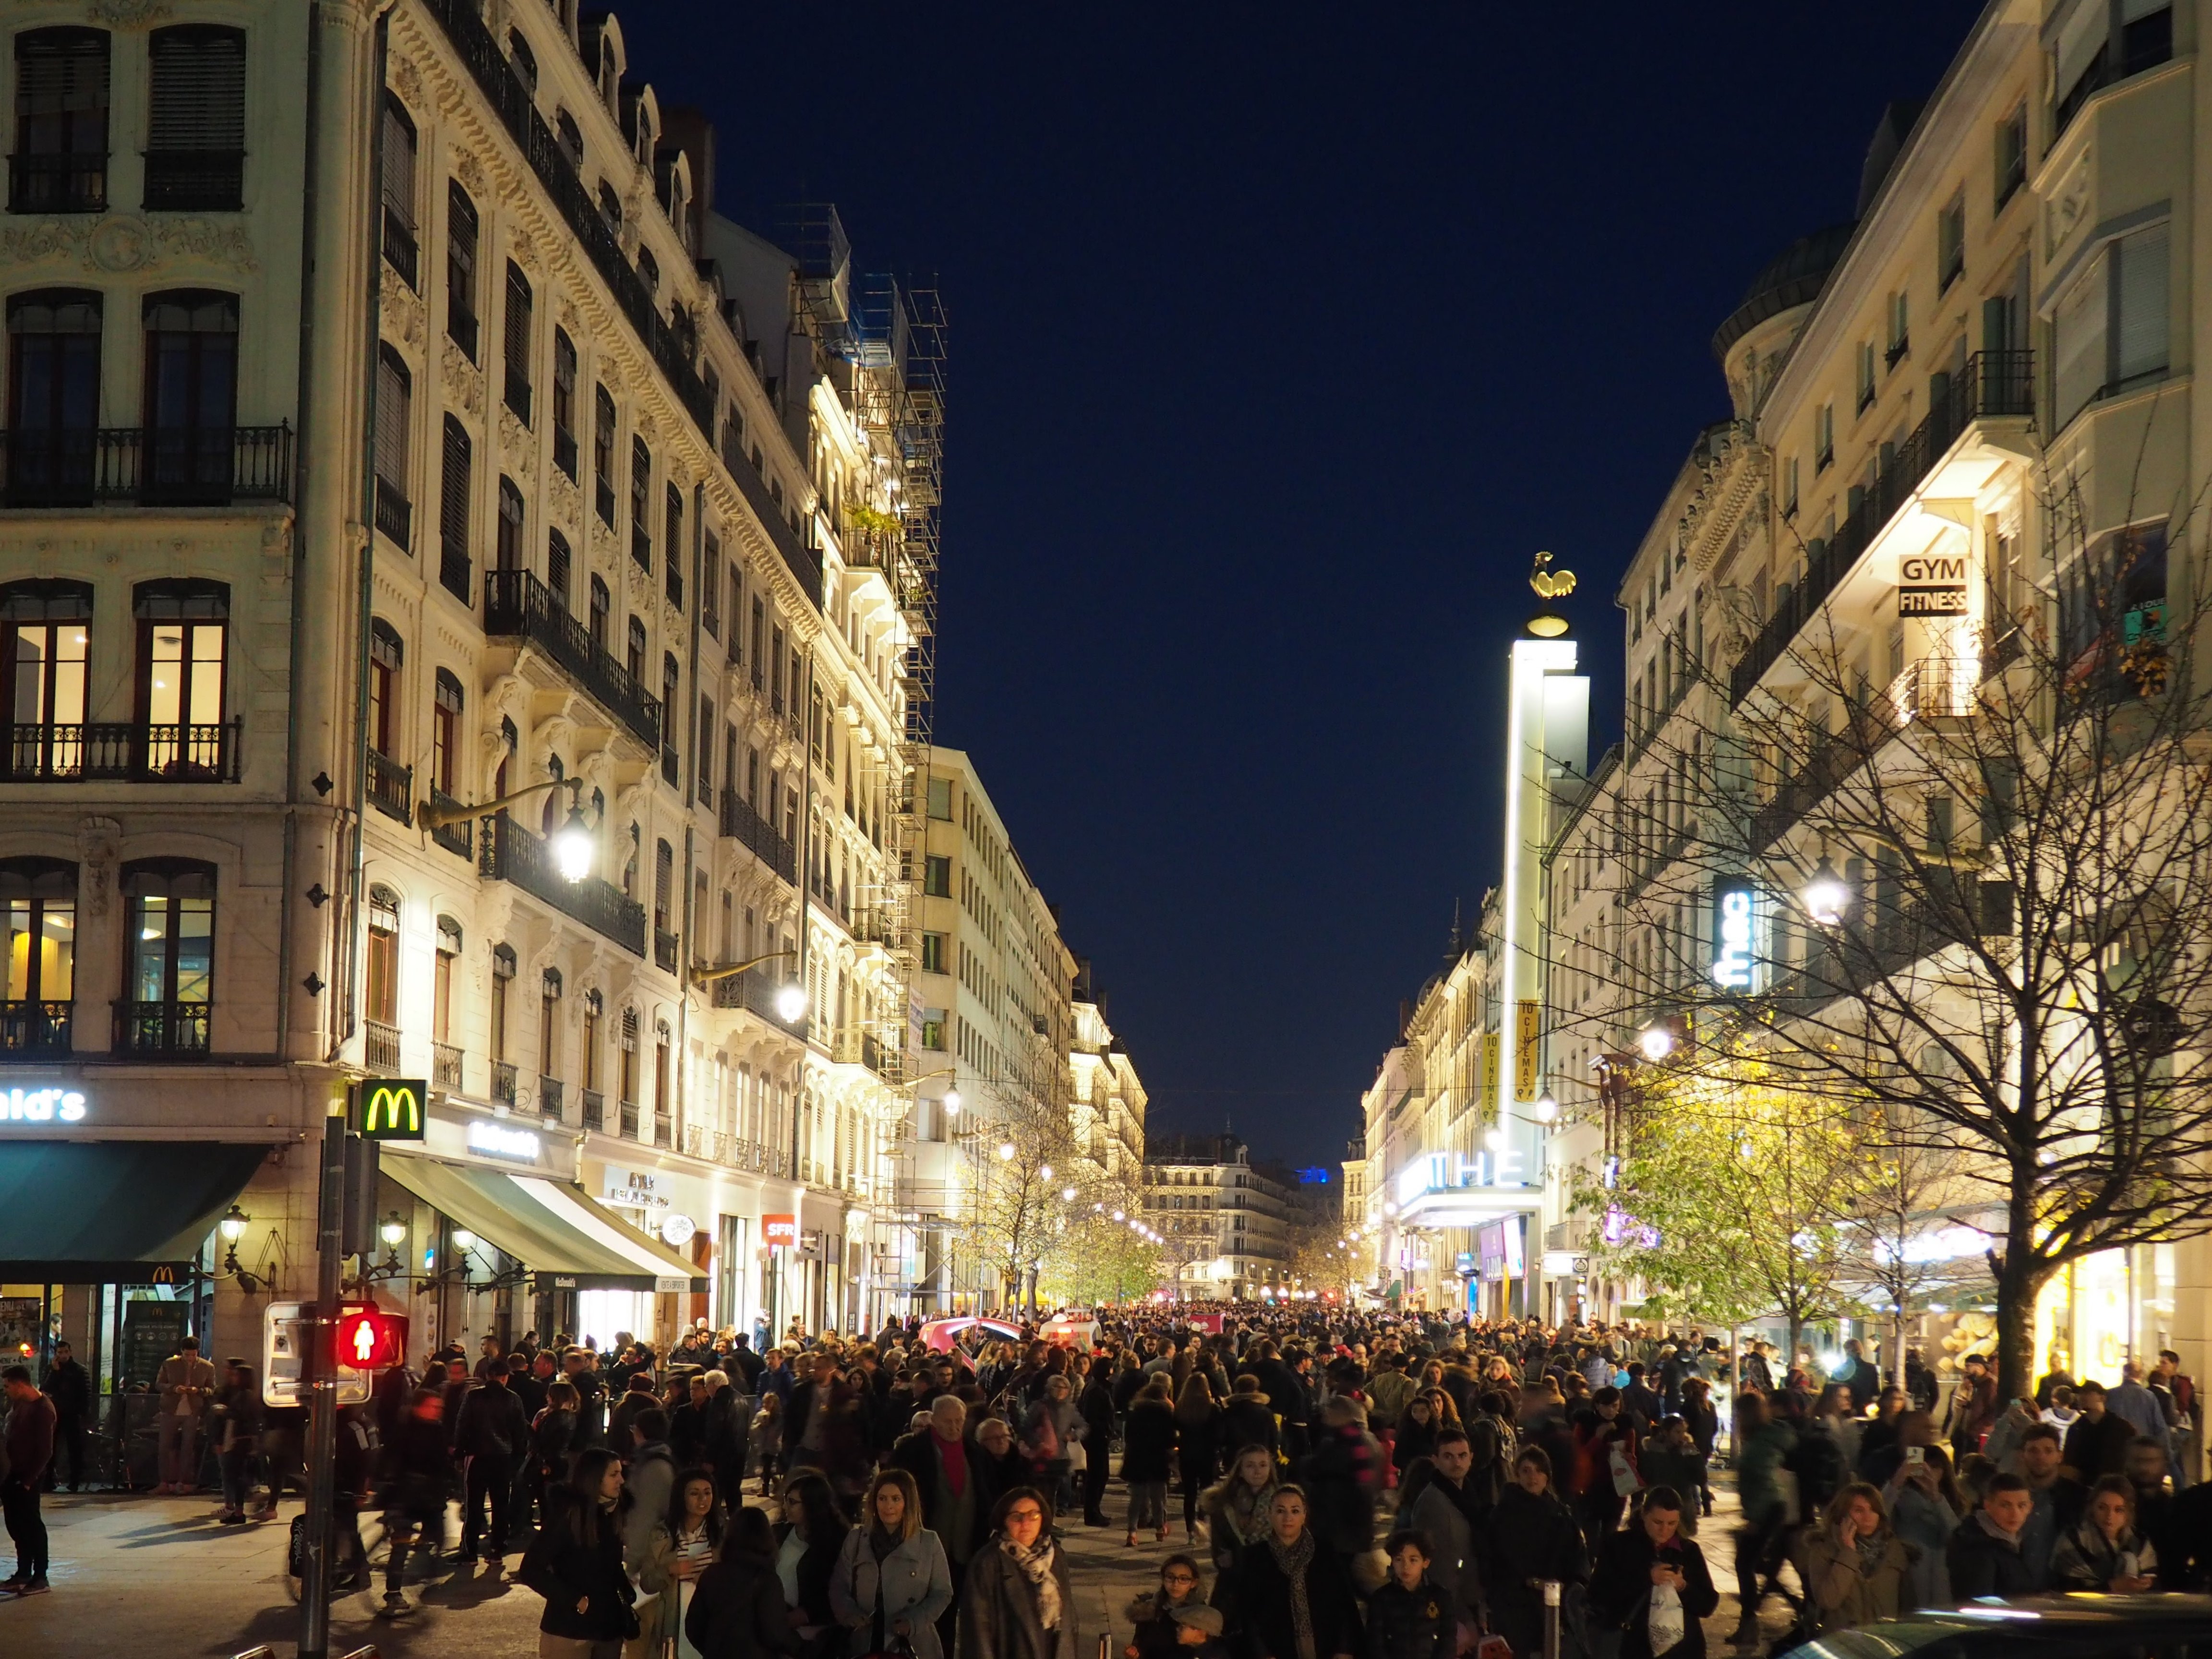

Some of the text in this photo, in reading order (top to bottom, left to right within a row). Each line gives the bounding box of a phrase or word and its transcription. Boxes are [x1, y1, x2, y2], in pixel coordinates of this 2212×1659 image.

[1902, 559, 1965, 580] GYM
[1900, 591, 1967, 610] FITNESS
[1522, 1002, 1533, 1014] 10
[1487, 1037, 1497, 1047] 10
[768, 1223, 794, 1236] SFR
